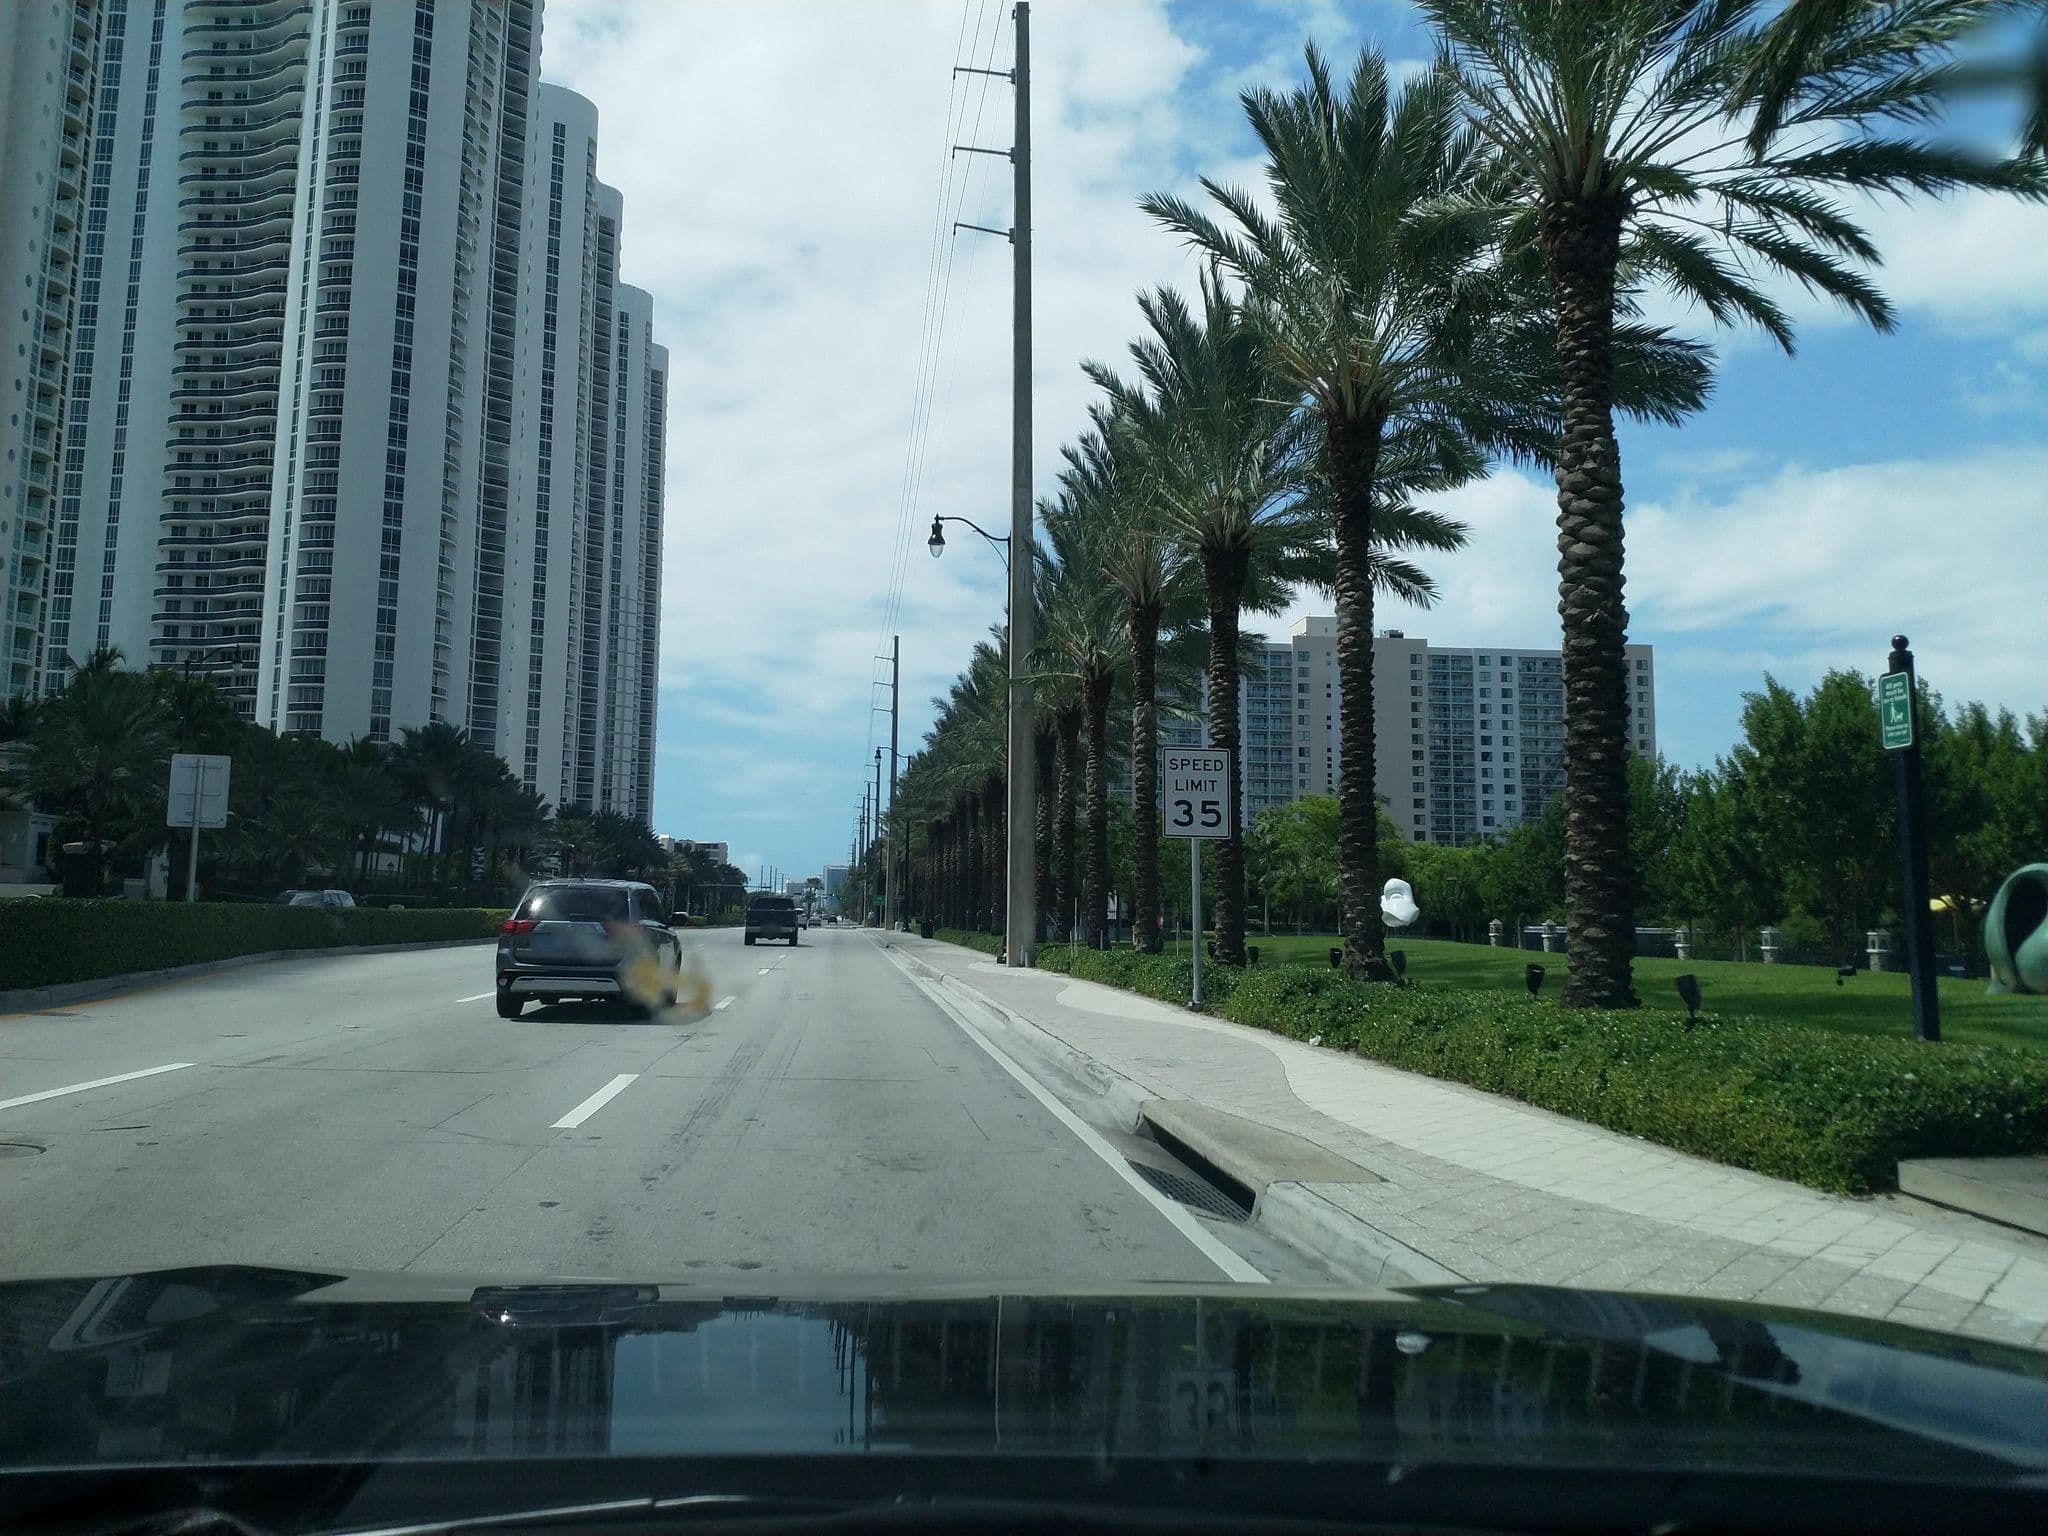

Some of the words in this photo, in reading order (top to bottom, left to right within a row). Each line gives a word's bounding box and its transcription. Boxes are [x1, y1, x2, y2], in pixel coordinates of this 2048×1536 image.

[1169, 758, 1224, 772] SPEED
[1175, 779, 1218, 792] LIMIT
[1173, 800, 1222, 828] 35
